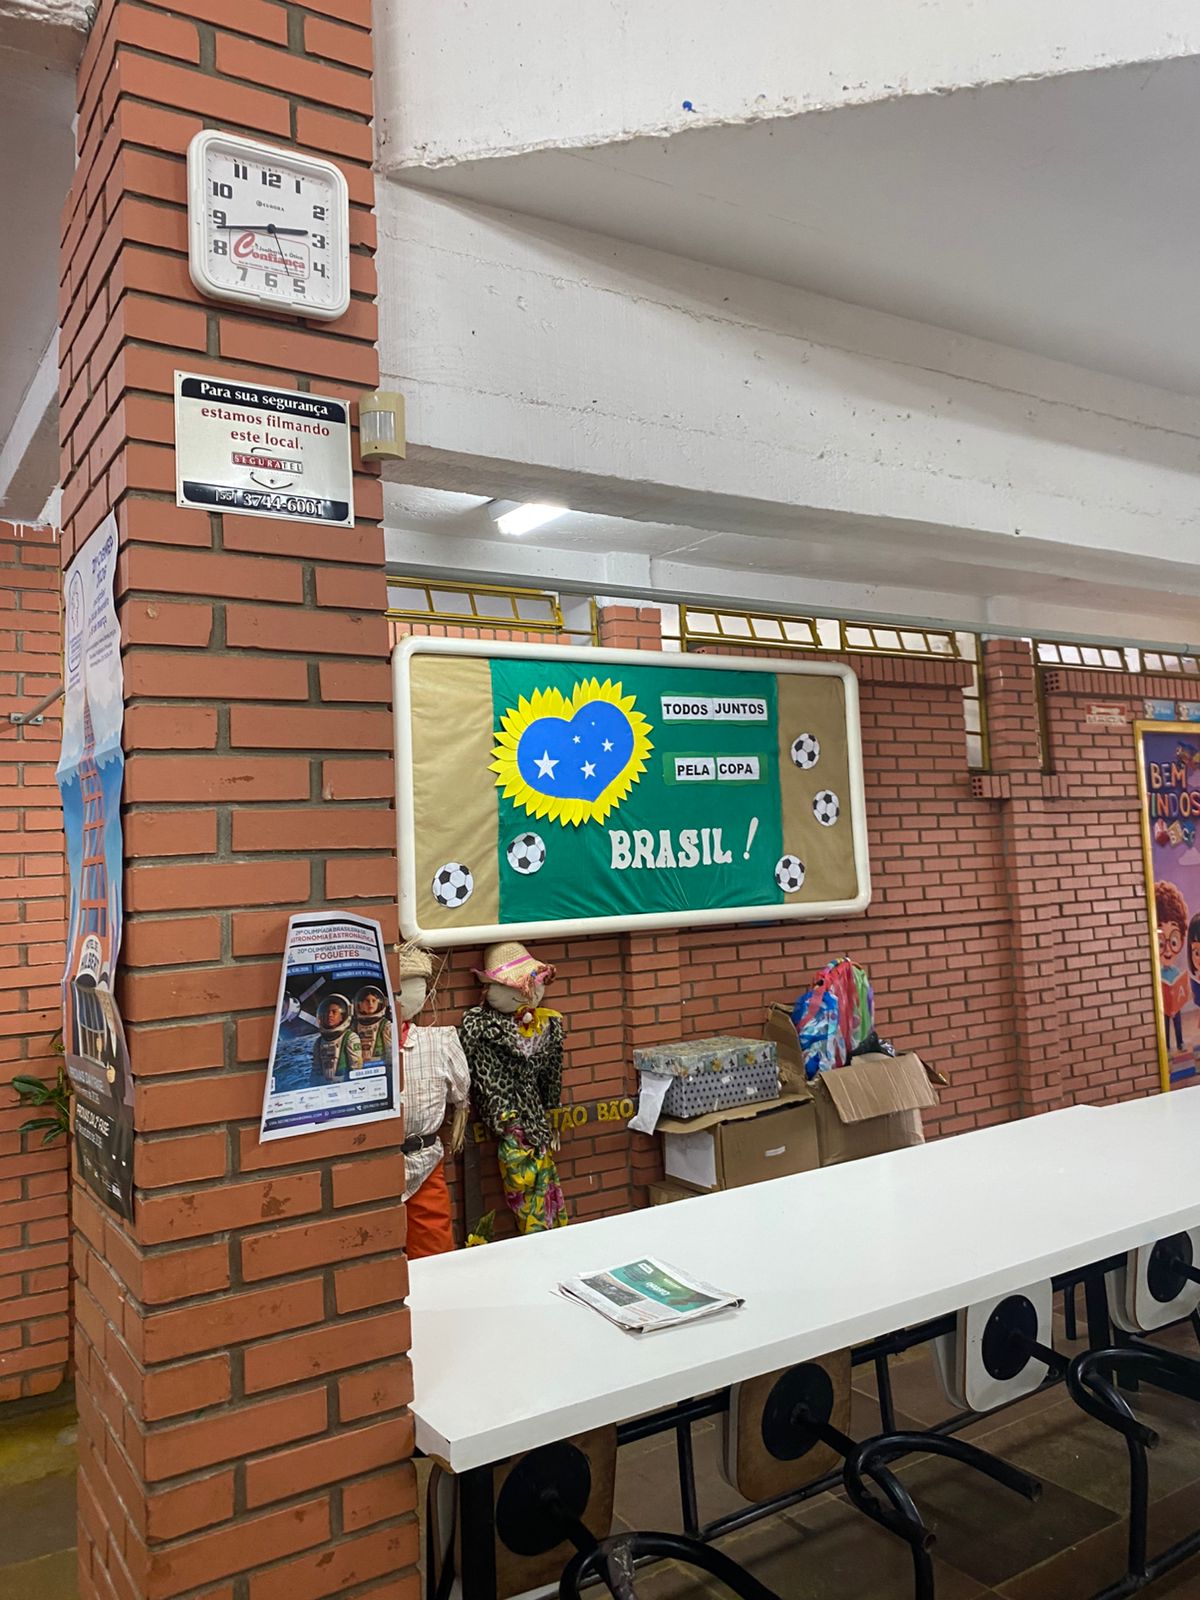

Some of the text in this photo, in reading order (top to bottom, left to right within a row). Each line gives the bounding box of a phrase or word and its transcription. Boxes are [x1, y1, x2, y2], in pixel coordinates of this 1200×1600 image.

[234, 163, 248, 180] 11
[262, 171, 281, 189] 12
[213, 181, 233, 199] 10
[295, 180, 301, 194] 1
[213, 209, 227, 226] 9
[313, 205, 325, 221] 2
[213, 239, 227, 256] 8
[312, 233, 326, 249] 3
[234, 232, 305, 269] Confiança
[237, 266, 248, 281] 7
[313, 262, 325, 278] 4
[265, 272, 278, 288] 6
[293, 278, 306, 294] 5
[200, 382, 328, 416] Para sua segurança
[201, 407, 330, 437] estamos filmando
[230, 430, 304, 450] este local.
[234, 454, 302, 472] SEGURATEL
[243, 492, 324, 516] 3744-6001
[663, 703, 765, 716] TODOS JUNTOS
[677, 763, 753, 776] PELA COPA
[1150, 762, 1187, 789] BEM
[608, 828, 733, 870] BRASIL
[314, 950, 360, 960] FOGUETES
[596, 1098, 634, 1121] BÃO
